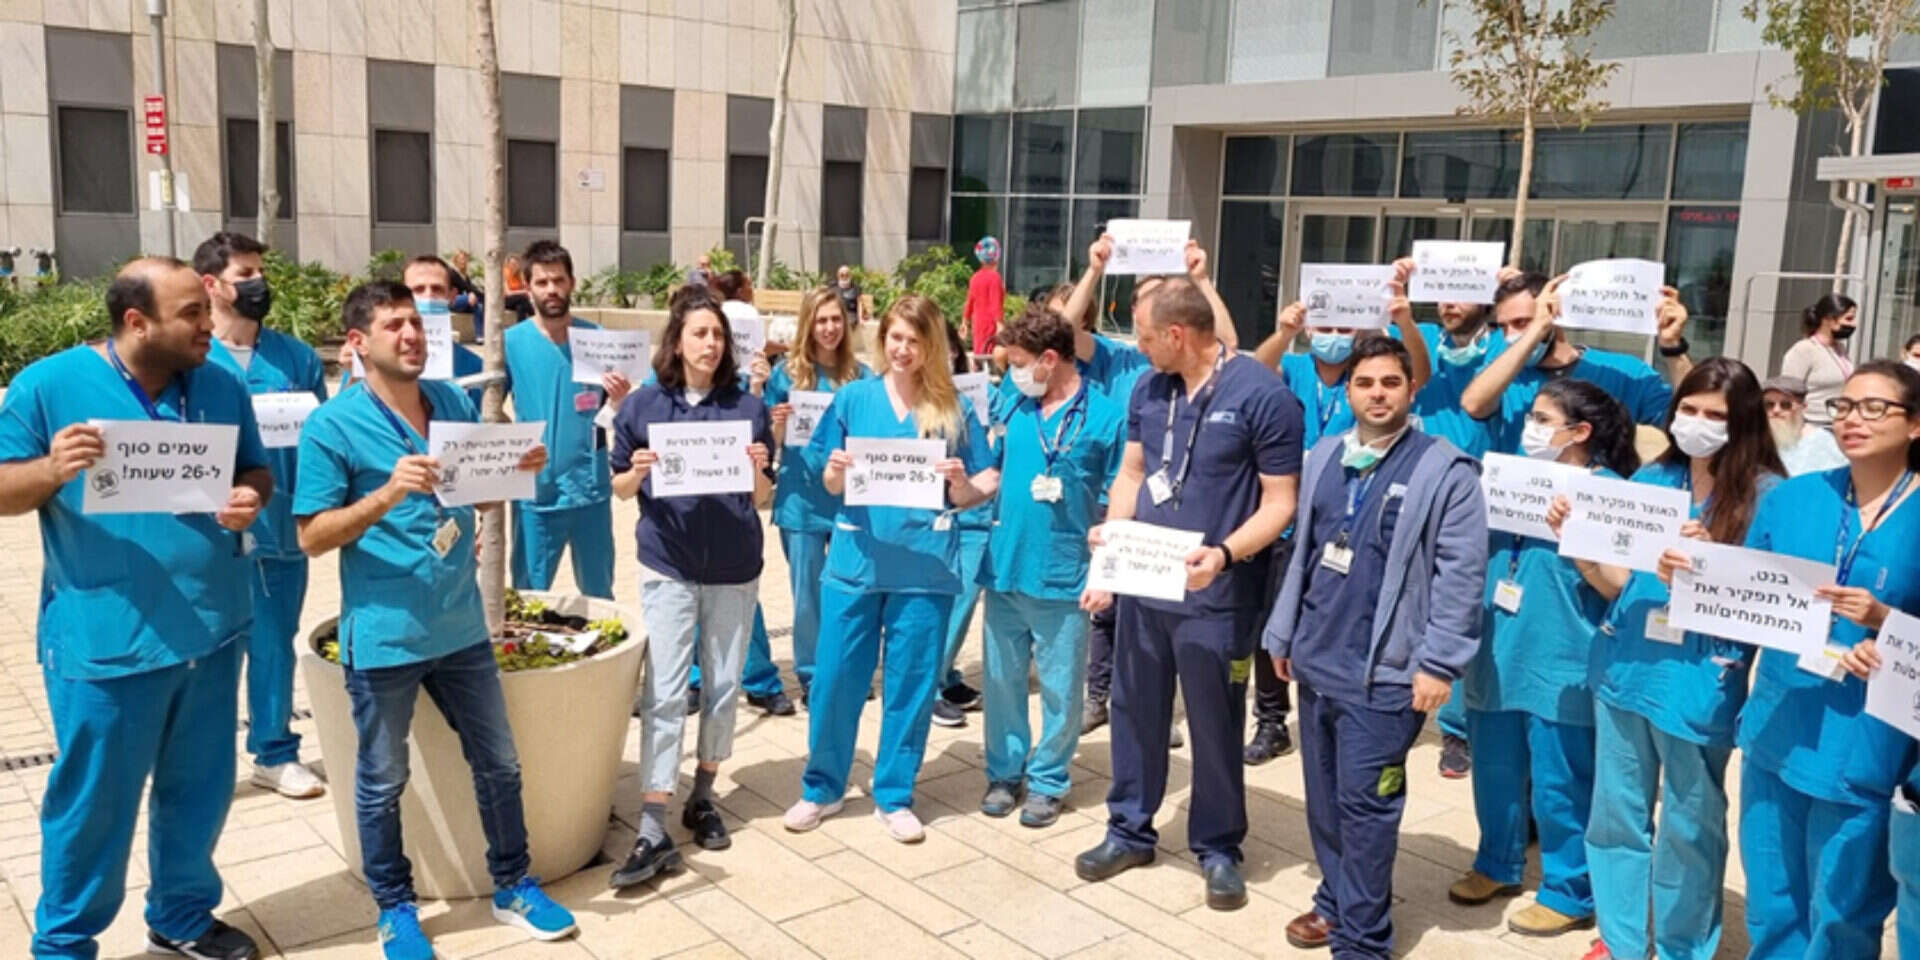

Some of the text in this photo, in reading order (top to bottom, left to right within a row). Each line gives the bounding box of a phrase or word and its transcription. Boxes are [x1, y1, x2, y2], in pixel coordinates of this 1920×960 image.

[1421, 267, 1437, 275] את
[1473, 267, 1487, 275] אל
[1571, 288, 1648, 301] אל תפקיר את
[711, 436, 737, 446] קיצור
[117, 442, 209, 458] שמים סוף
[865, 453, 927, 464] שמים סוף
[122, 463, 222, 481] ל-26 שעות!
[692, 465, 740, 478] 18 שעות!
[869, 469, 906, 482] שעות!
[1525, 477, 1554, 489] בנט,
[1489, 488, 1505, 499] את
[1509, 490, 1547, 505] תפקיר
[1576, 491, 1680, 518] האוצר מפקיר את
[1586, 511, 1665, 533] המתמחים/ות
[1750, 570, 1790, 586] בנט,
[1693, 581, 1809, 611] אל תפקיר את
[1694, 602, 1804, 632] המתמחים/ות
[1886, 633, 1904, 650] את
